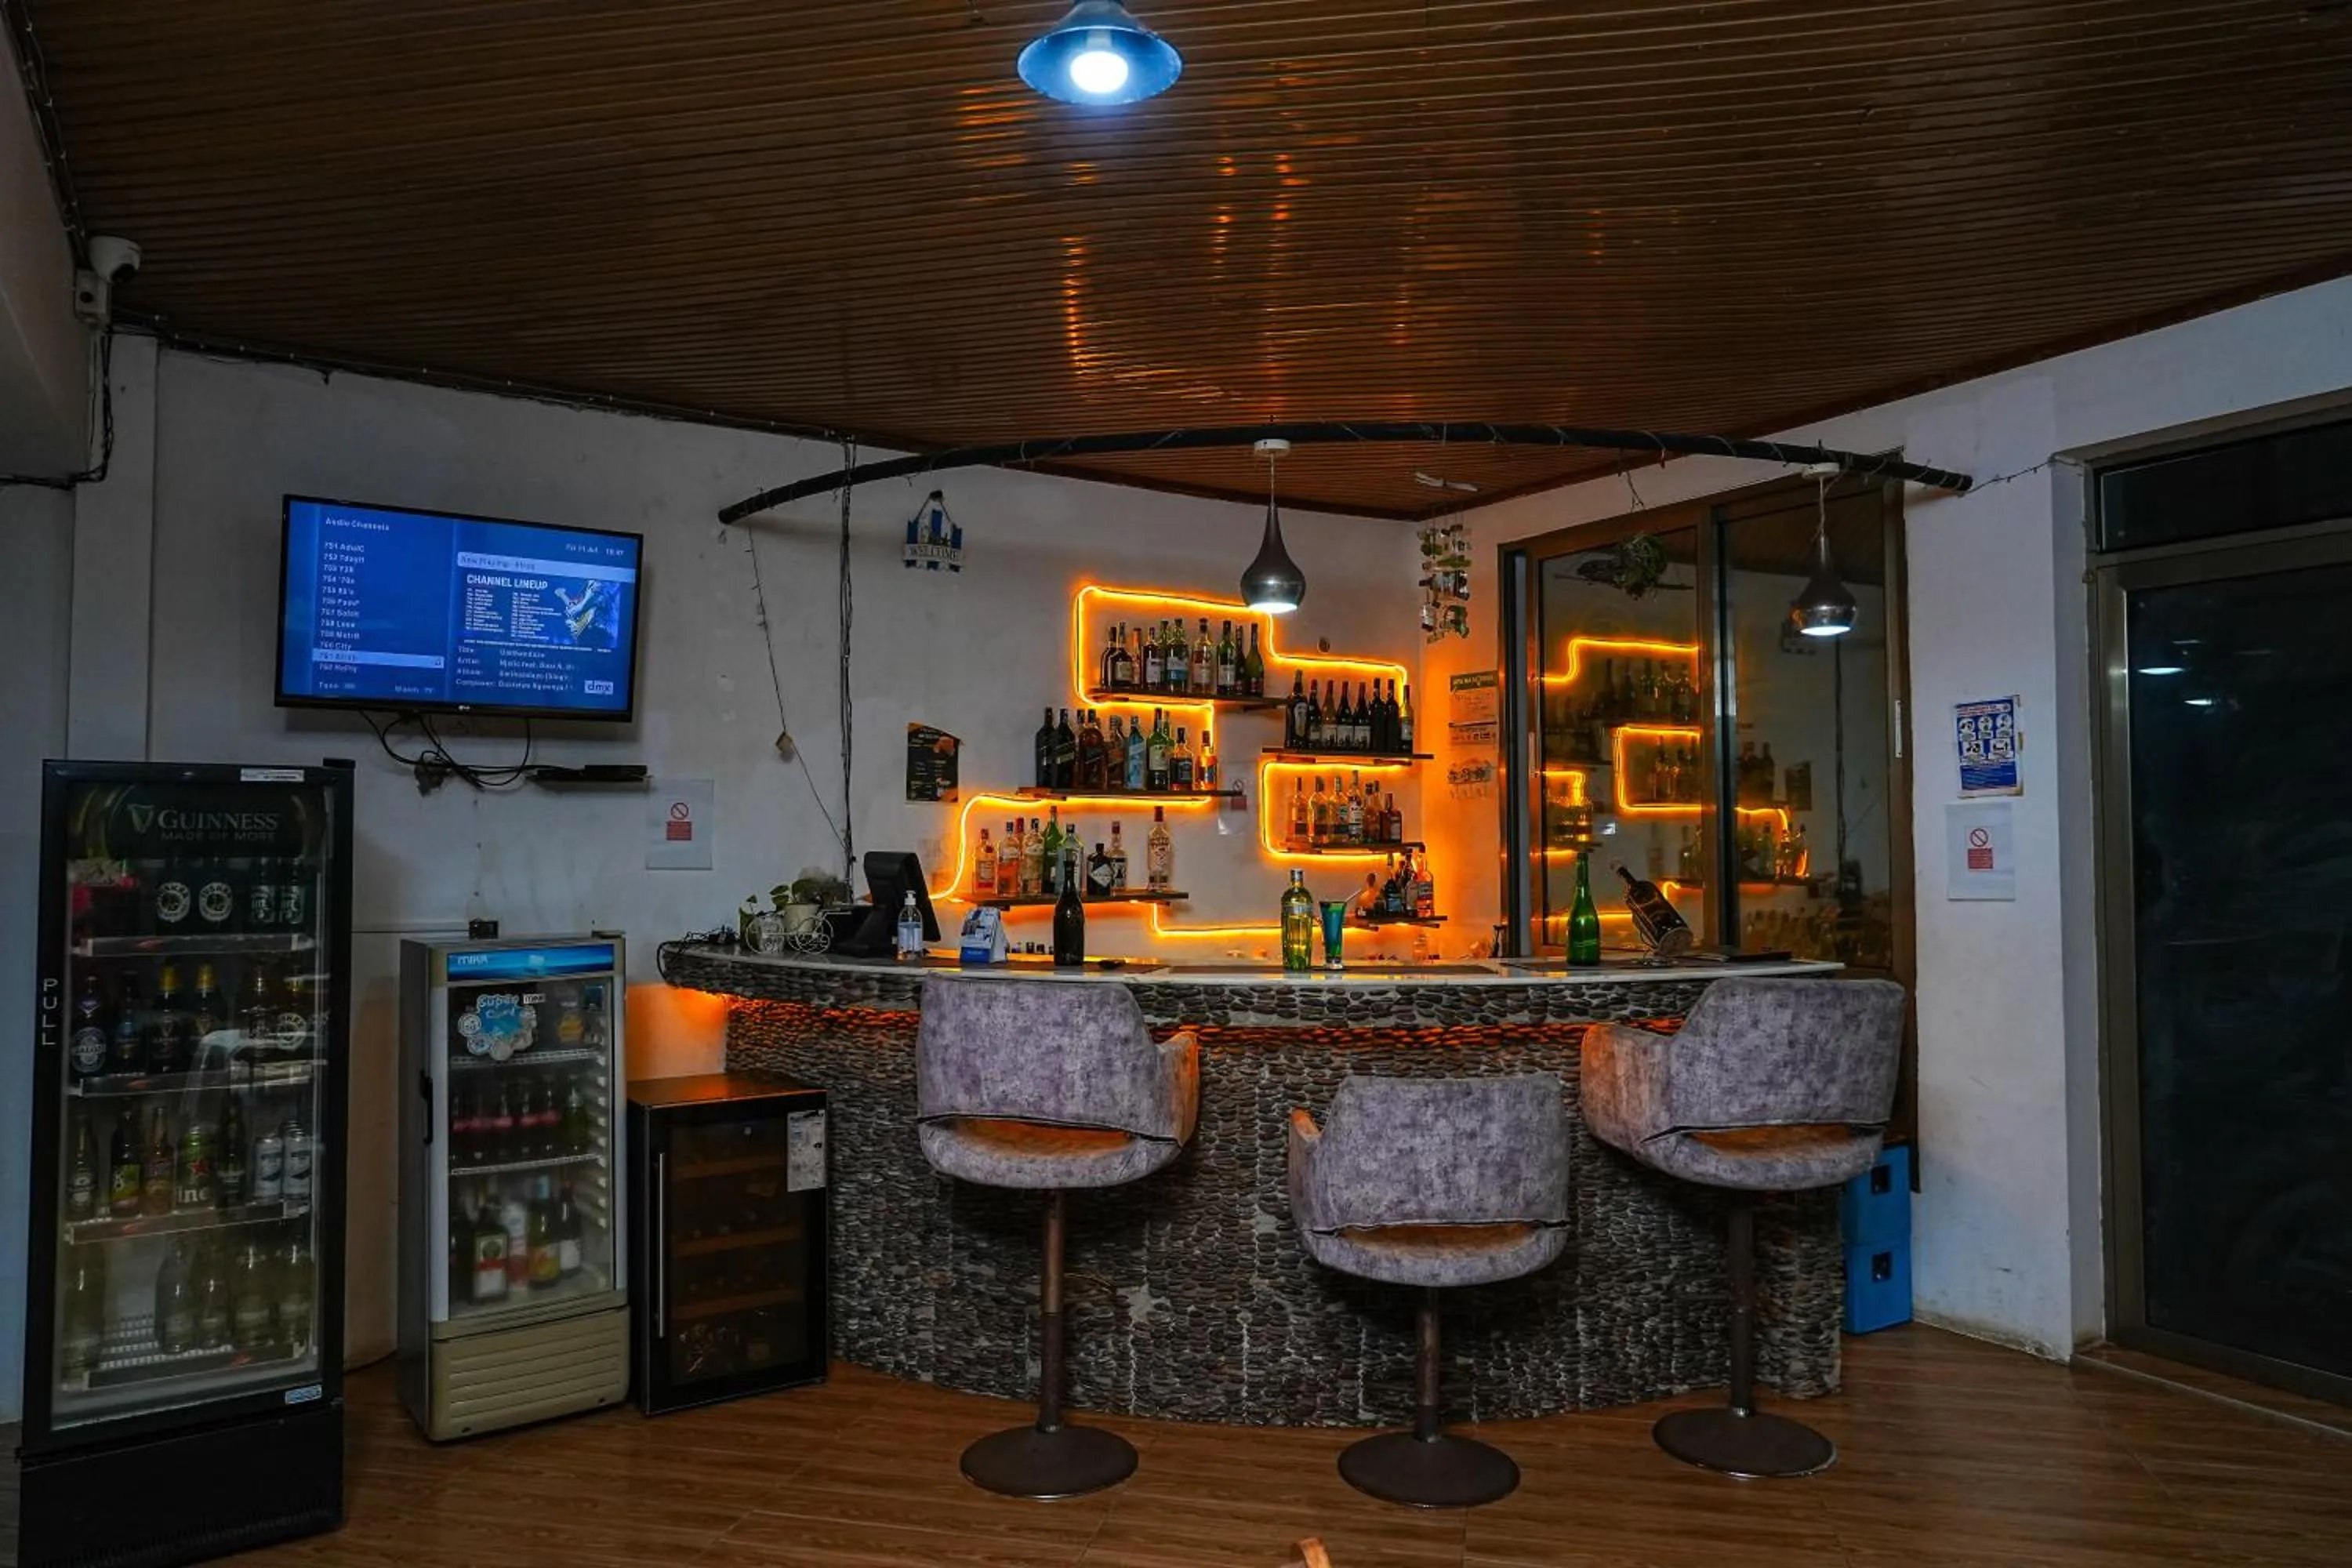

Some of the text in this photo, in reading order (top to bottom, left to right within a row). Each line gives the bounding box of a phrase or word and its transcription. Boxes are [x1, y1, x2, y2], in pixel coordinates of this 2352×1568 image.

[466, 574, 548, 590] CHANNEL LINEUP
[587, 680, 611, 691] dmx
[157, 807, 278, 831] GUINNESS
[42, 978, 60, 1047] PULL
